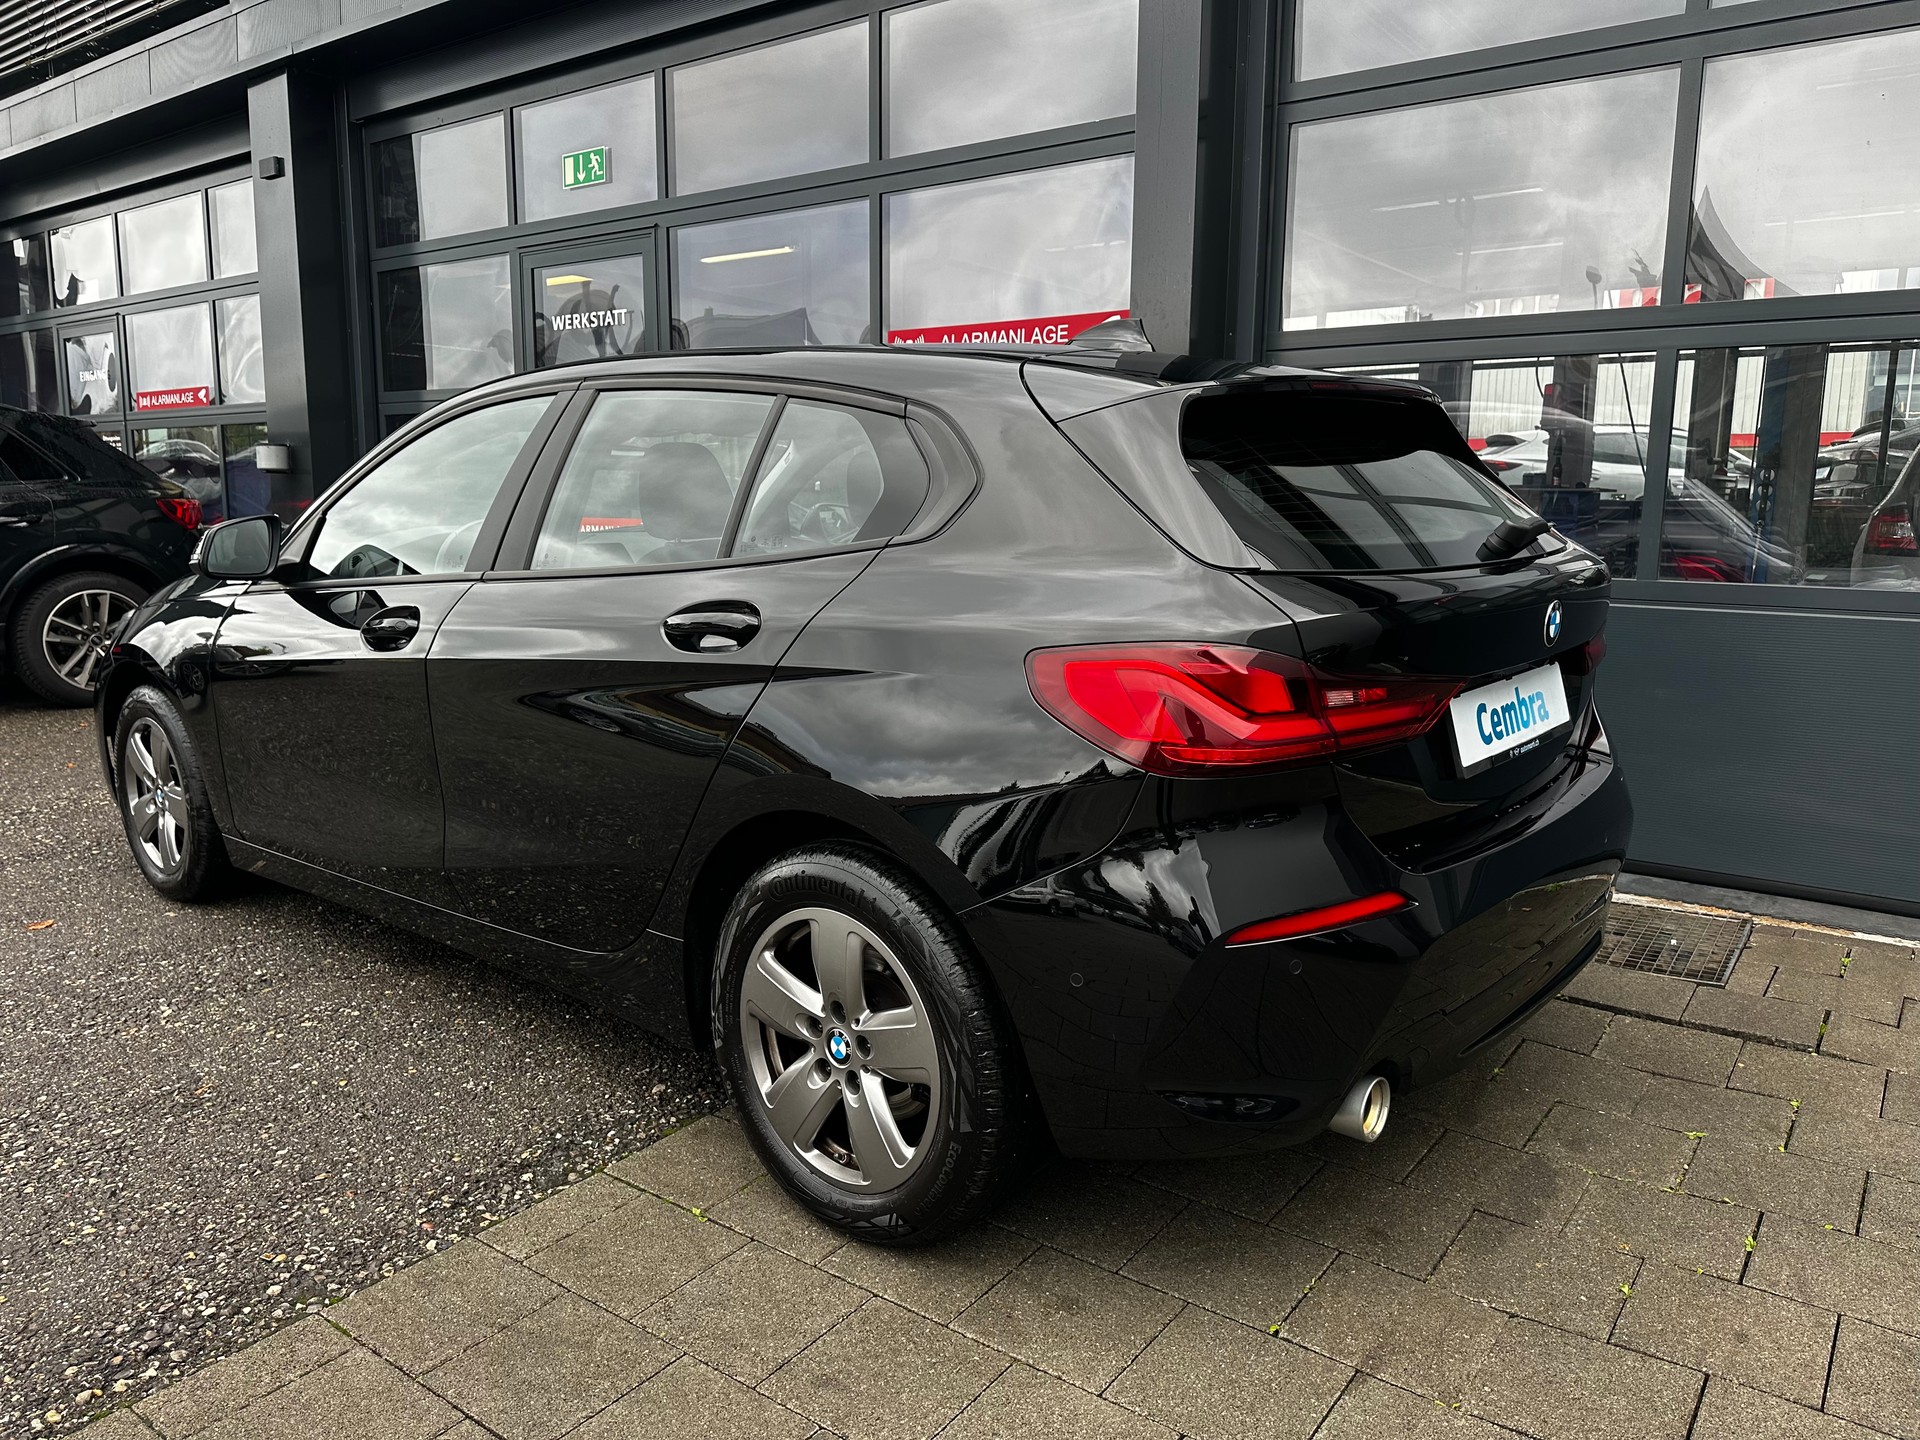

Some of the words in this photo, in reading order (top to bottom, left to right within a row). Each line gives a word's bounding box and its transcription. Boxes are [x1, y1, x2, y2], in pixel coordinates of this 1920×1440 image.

[551, 308, 628, 331] WERKSTATT
[151, 392, 194, 406] ALARMANLAGE
[1476, 686, 1549, 745] Cembra
[768, 869, 866, 908] Continental
